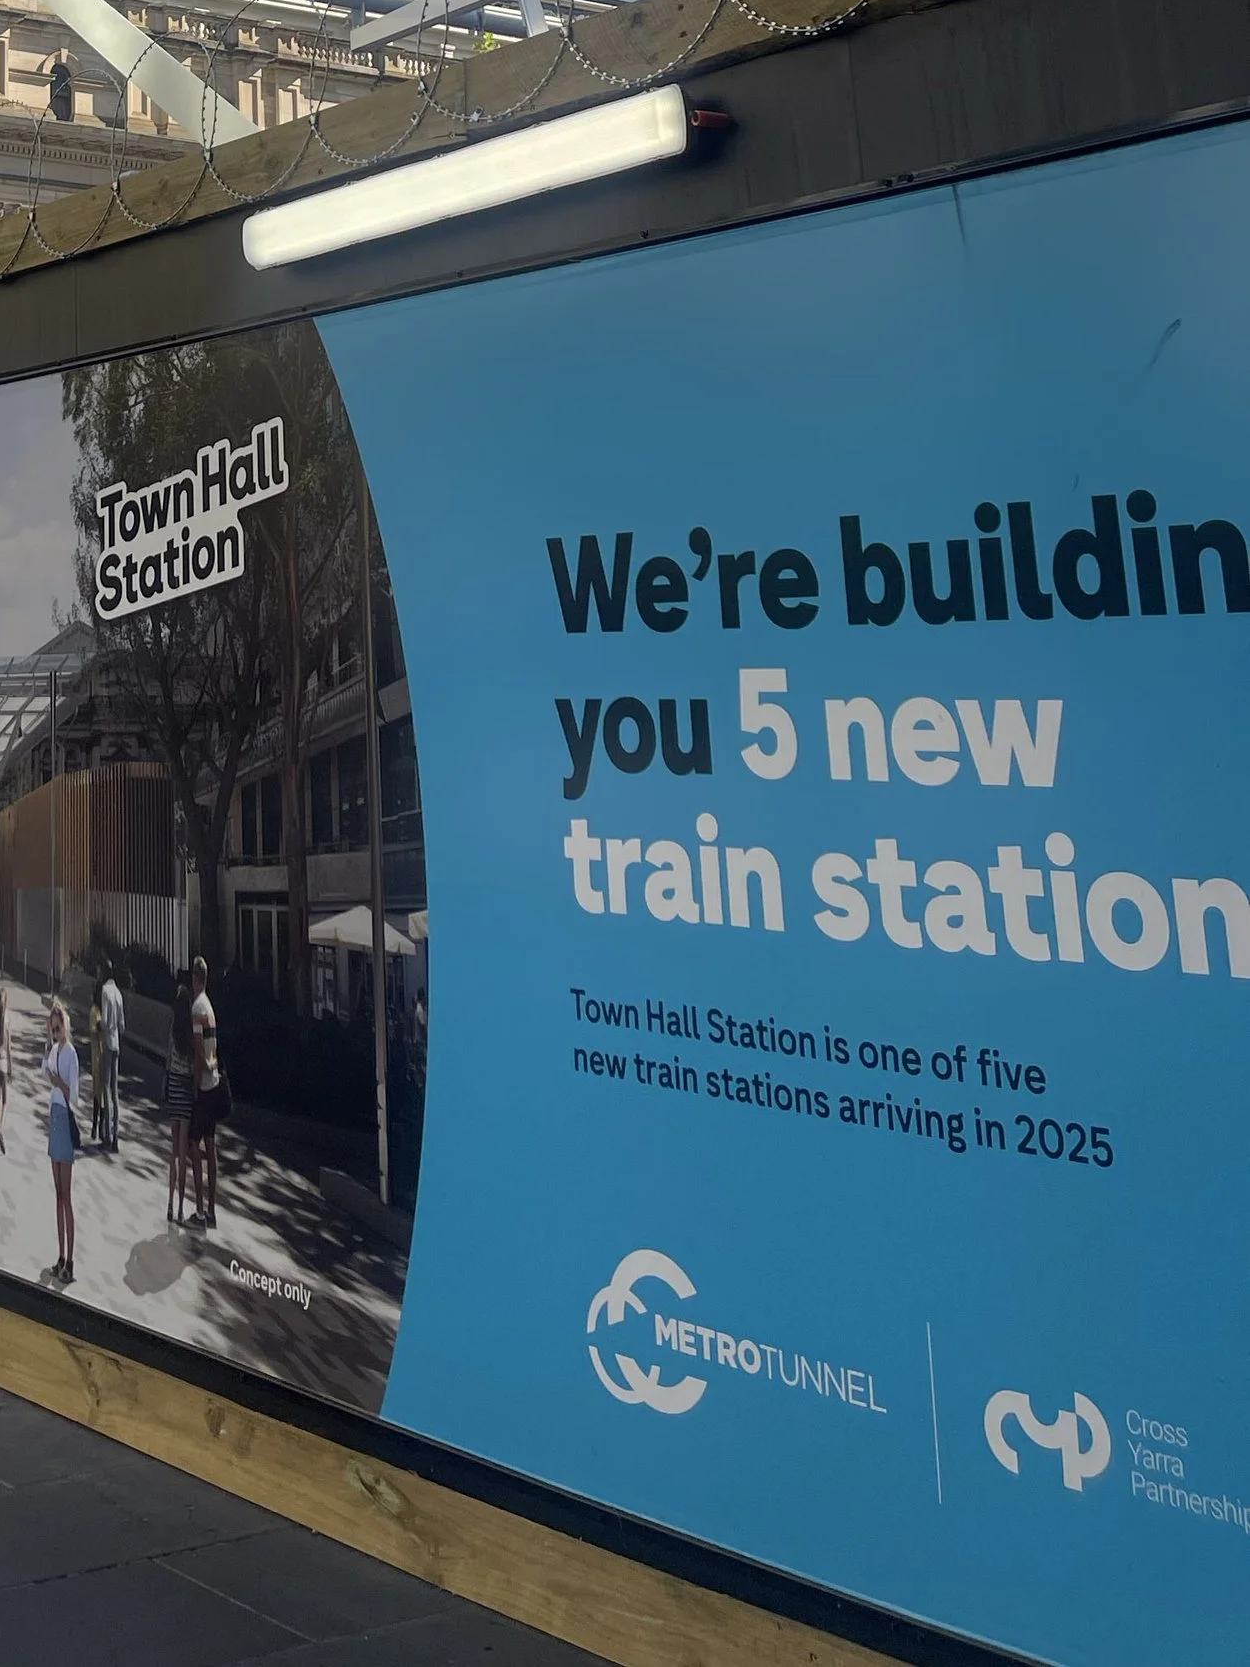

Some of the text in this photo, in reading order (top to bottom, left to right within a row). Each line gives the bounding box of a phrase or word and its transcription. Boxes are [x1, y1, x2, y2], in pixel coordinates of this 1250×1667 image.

[101, 425, 283, 548] Town Hall
[99, 525, 240, 612] Station
[546, 489, 1250, 634] We're buildin
[554, 667, 1064, 801] you 5 new
[563, 811, 1250, 979] train station
[570, 988, 1047, 1095] Town Hall Station is one of five
[574, 1047, 1114, 1168] new train stations arriving in 2025
[230, 1259, 311, 1311] Concept only
[654, 1313, 888, 1414] METROTUNNEL
[1126, 1409, 1188, 1447] Cross
[1127, 1439, 1184, 1478] Yarra
